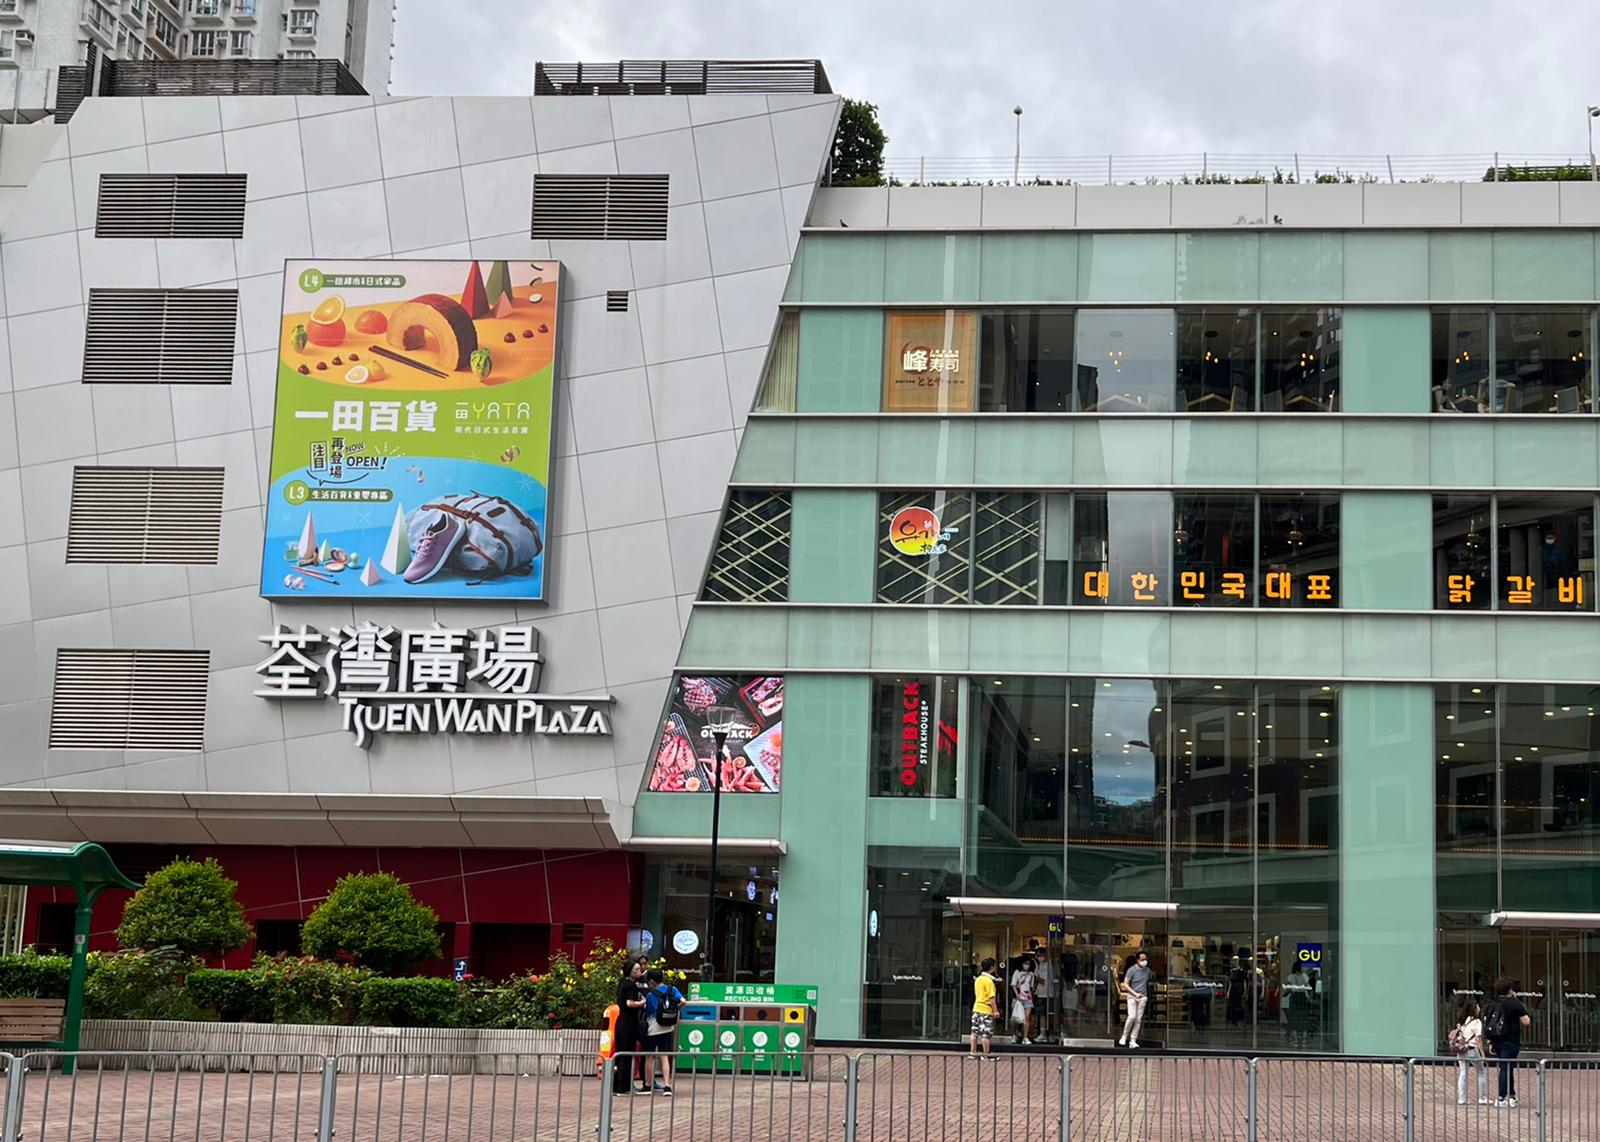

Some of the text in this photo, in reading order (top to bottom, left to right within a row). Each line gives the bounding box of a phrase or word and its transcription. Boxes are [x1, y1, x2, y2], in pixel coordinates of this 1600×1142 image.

[304, 275, 319, 287] L4
[295, 400, 438, 432] 一田百貨
[313, 444, 325, 469] 注目
[330, 437, 344, 479] 再登場
[345, 442, 364, 453] NOW
[290, 486, 304, 499] L3
[1448, 575, 1583, 604] 닭갈비
[254, 621, 540, 696] 荃灣廣場
[901, 679, 920, 786] OUTBACK
[1298, 949, 1321, 962] GU
[725, 985, 775, 995] 資源回收桶
